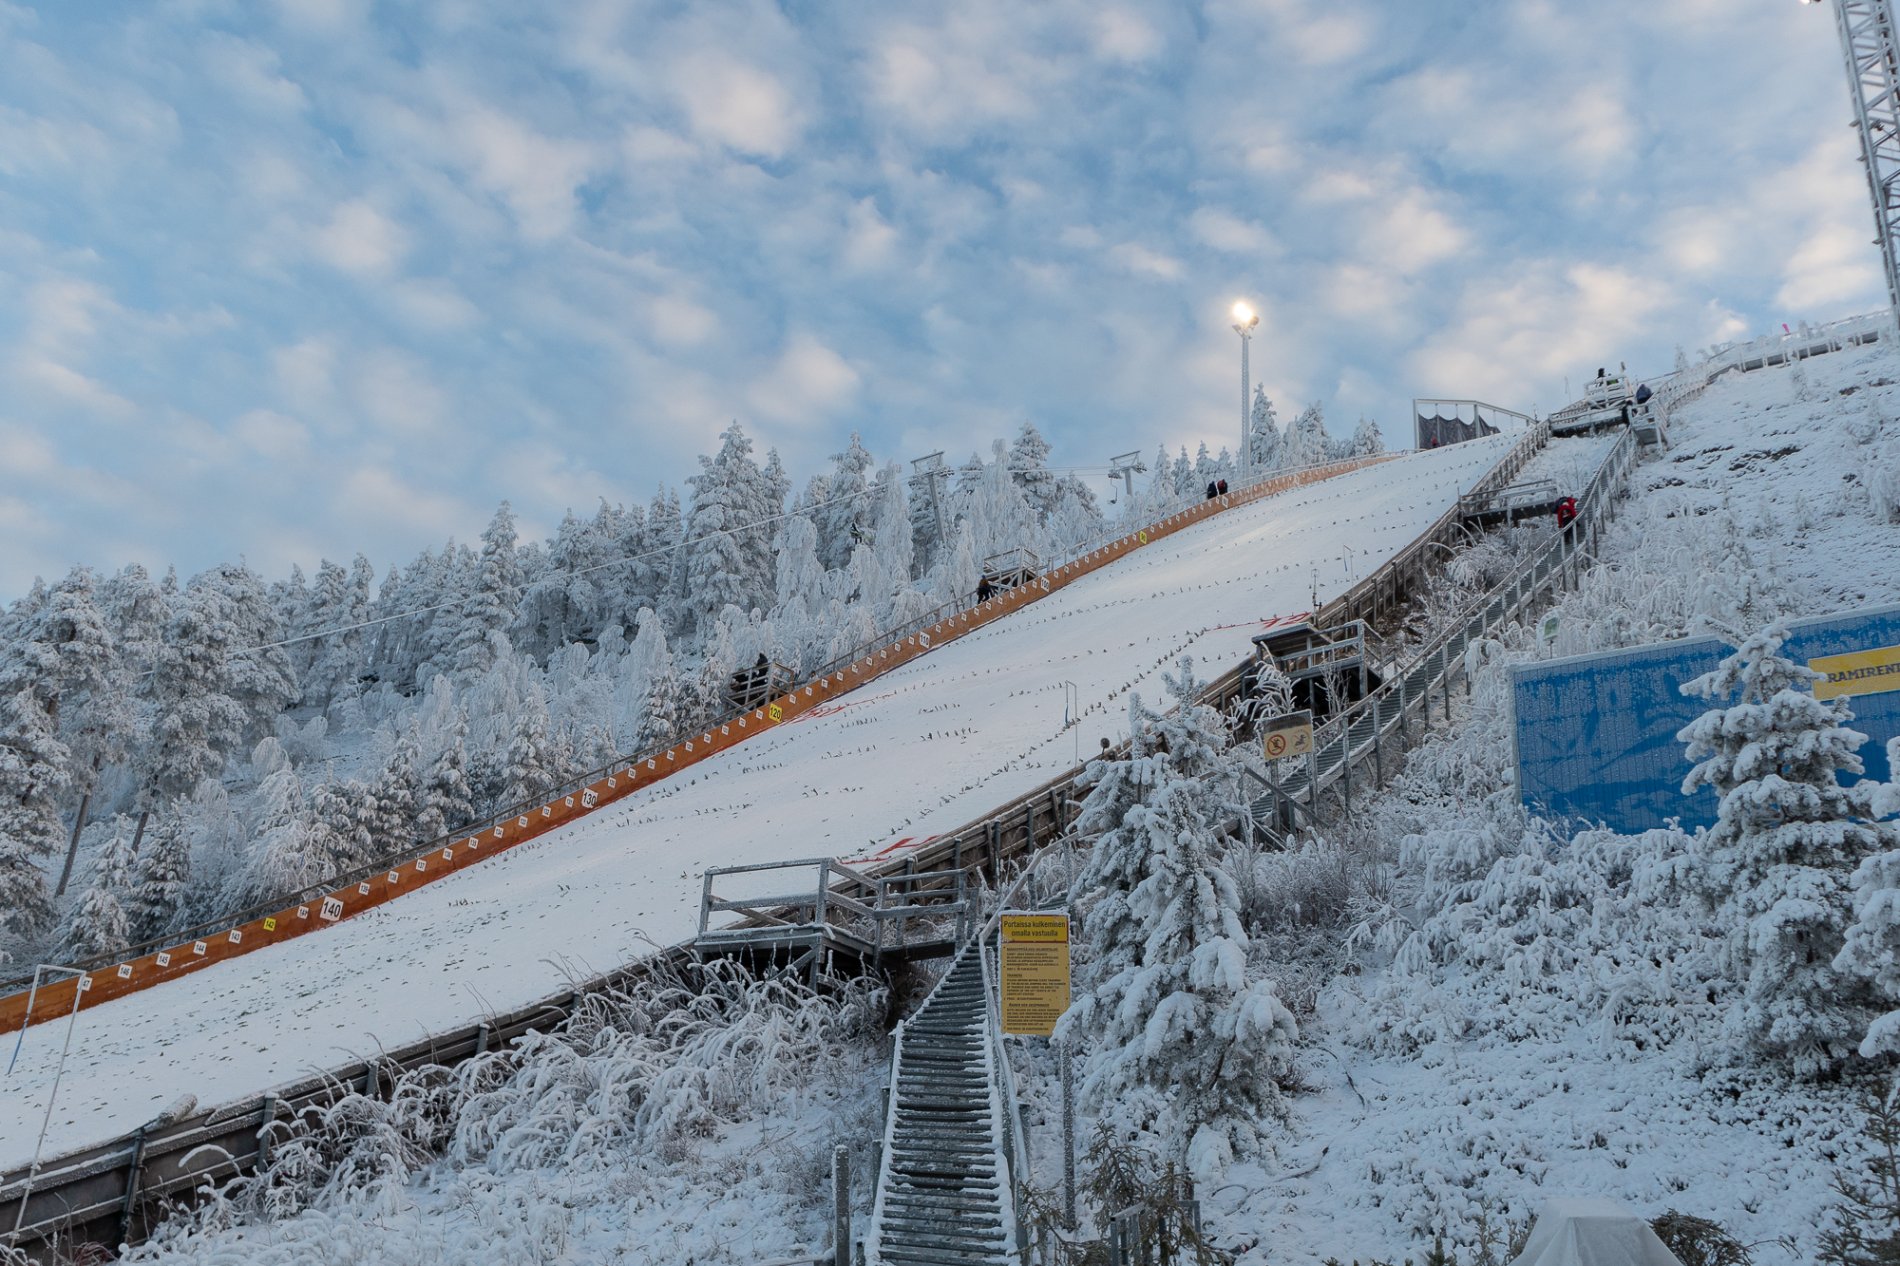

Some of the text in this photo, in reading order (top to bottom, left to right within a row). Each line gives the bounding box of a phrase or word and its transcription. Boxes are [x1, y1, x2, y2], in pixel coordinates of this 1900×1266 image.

[770, 706, 781, 719] 120
[584, 792, 596, 804] 130
[324, 901, 341, 918] 140
[266, 920, 274, 929] 142
[231, 932, 240, 941] 143
[196, 943, 204, 952] 144
[159, 955, 168, 964] 145
